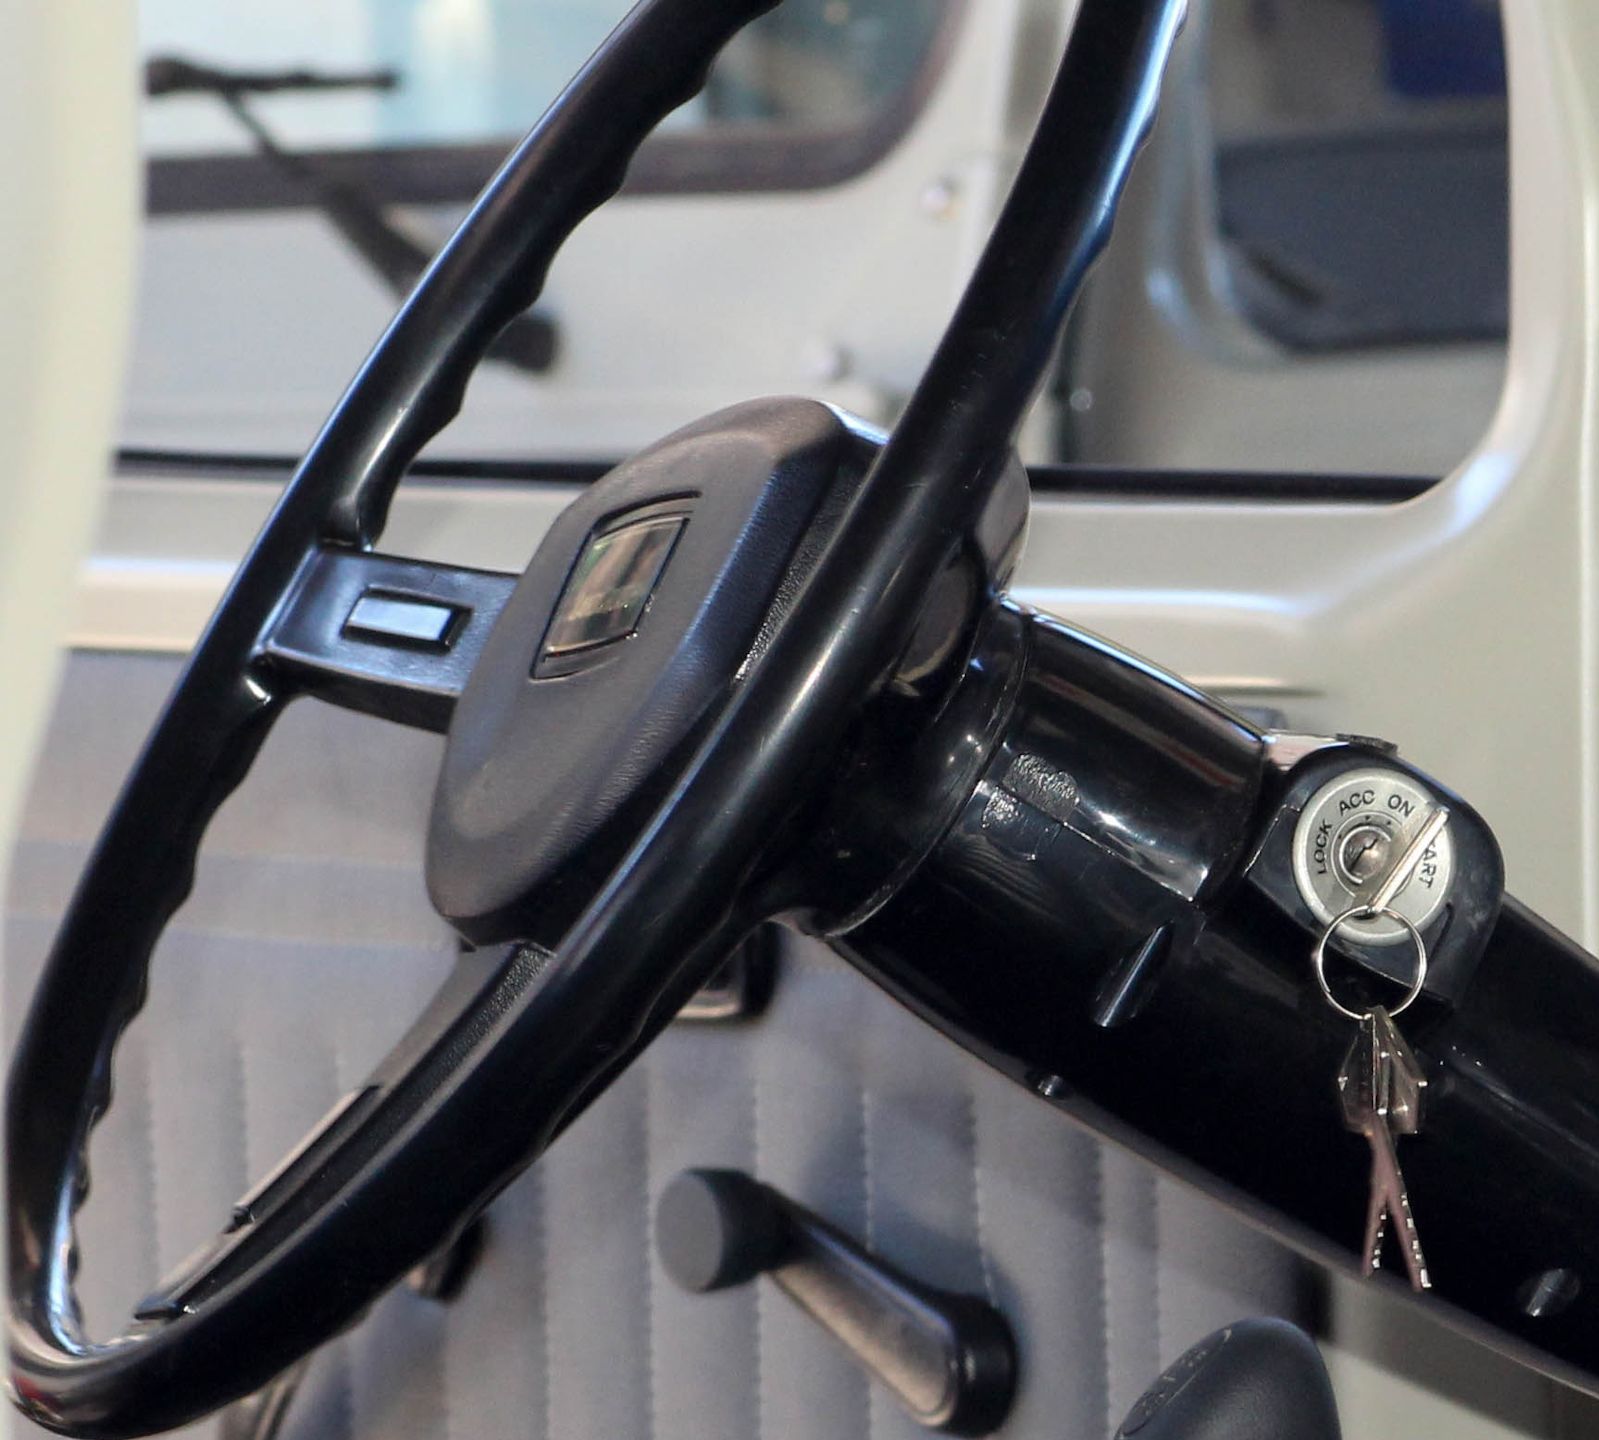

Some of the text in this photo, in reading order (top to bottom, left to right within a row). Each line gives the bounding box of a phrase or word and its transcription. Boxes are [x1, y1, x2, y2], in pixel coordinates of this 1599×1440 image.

[1339, 790, 1375, 816] ACC
[1388, 794, 1415, 817] ON
[1314, 819, 1332, 874] LOCK
[1418, 839, 1437, 888] ART
